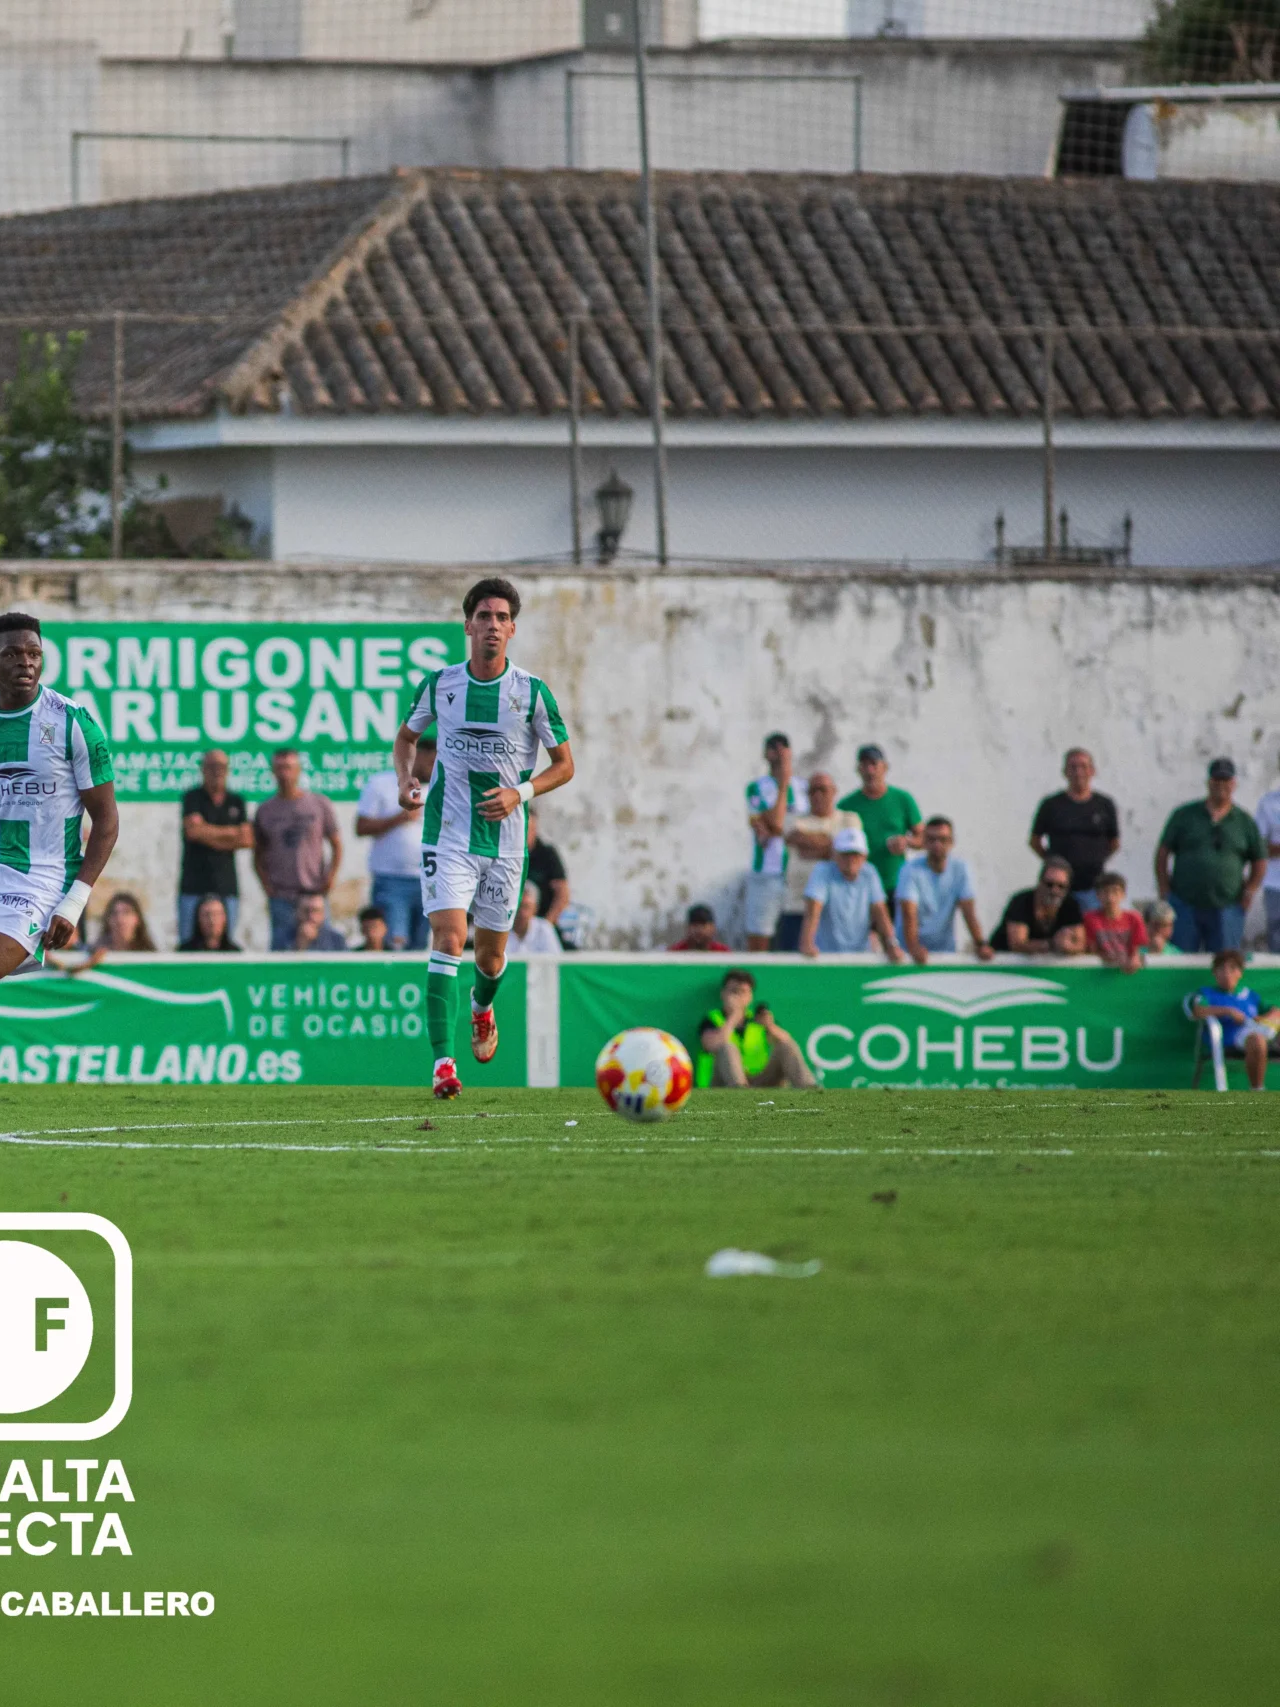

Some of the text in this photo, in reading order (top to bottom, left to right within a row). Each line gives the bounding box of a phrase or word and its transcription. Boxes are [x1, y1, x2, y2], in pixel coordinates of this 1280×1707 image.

[70, 690, 398, 742] ARLUSAN
[445, 737, 517, 754] COHEBU
[423, 852, 437, 877] 5
[247, 979, 421, 1009] VEHÍCULO
[248, 1012, 423, 1038] DE OCASIÓ
[806, 1023, 1124, 1073] COHEBU
